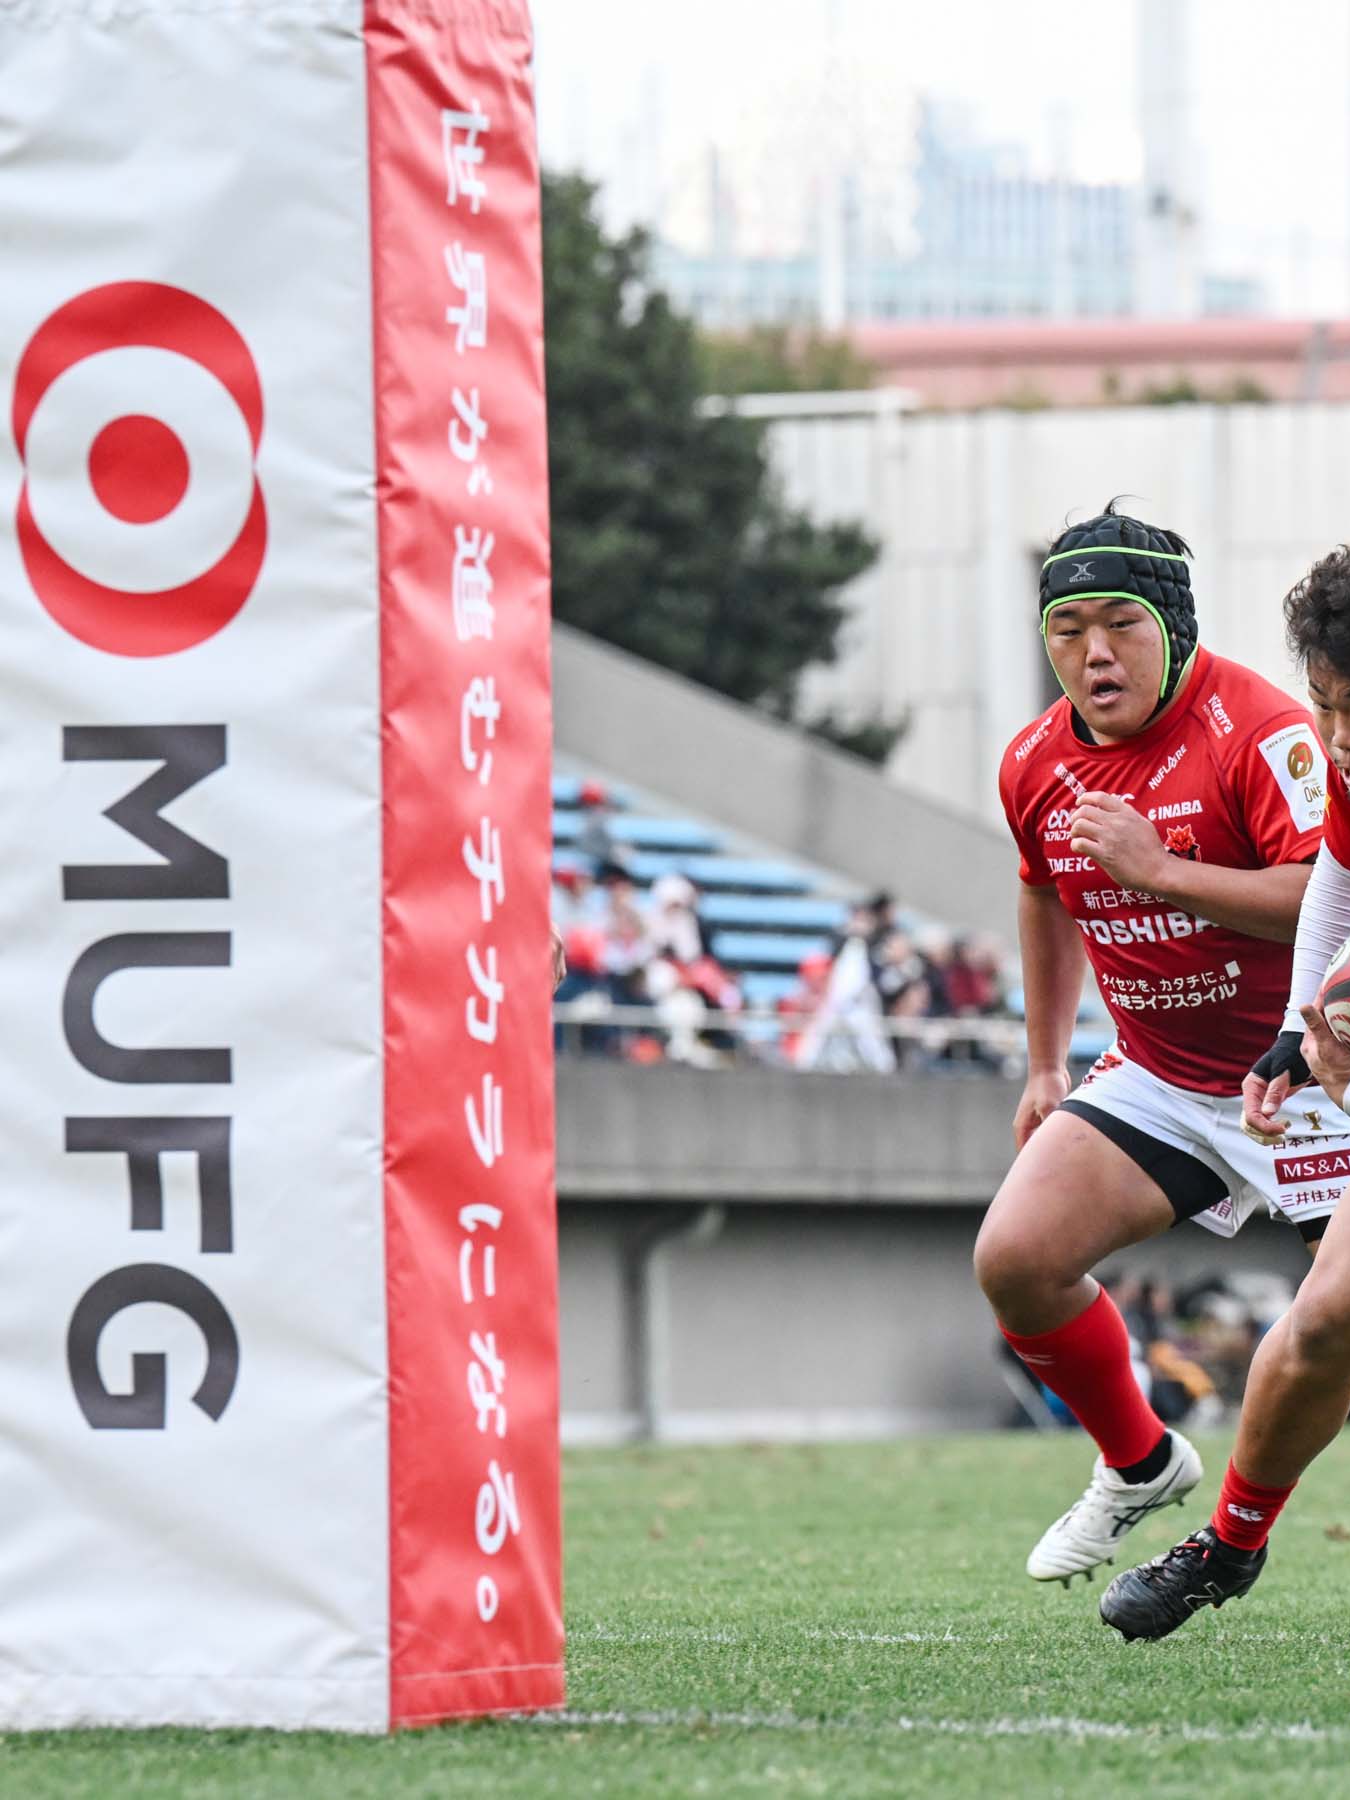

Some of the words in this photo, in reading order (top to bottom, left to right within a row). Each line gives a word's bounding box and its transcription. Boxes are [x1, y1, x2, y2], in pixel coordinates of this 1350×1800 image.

[1304, 785, 1324, 803] ONE
[442, 99, 519, 1621] 世界が進むチカラになる。
[1082, 888, 1164, 909] 新日本空
[62, 724, 240, 1429] MUFG
[1280, 1187, 1347, 1208] 三井住友
